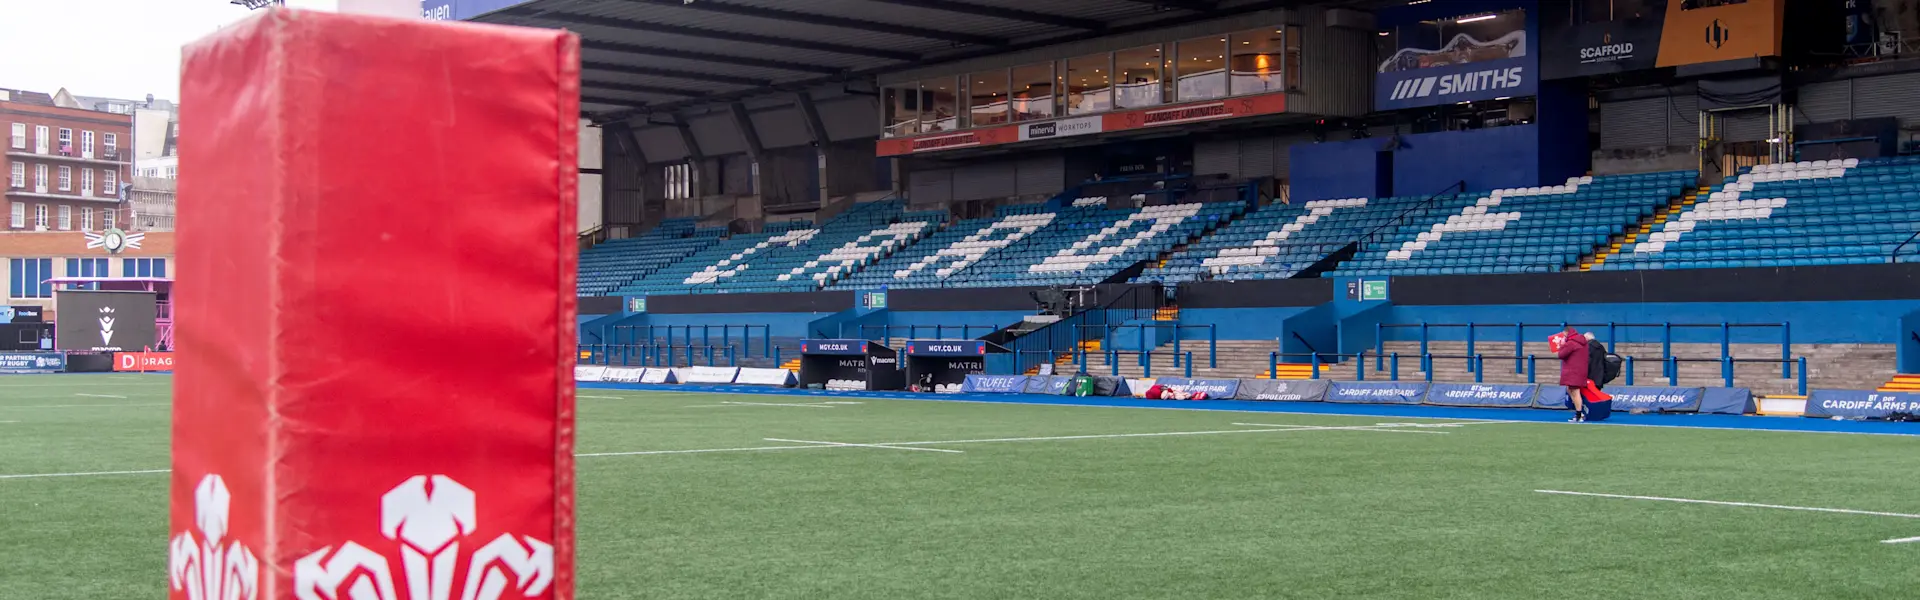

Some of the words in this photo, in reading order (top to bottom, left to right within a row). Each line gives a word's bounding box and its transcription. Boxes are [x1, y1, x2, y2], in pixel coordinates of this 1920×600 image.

[1580, 42, 1634, 59] SCAFFOLD
[1438, 66, 1523, 96] SMITHS
[1143, 109, 1181, 124] LLANDAFF
[1181, 104, 1224, 119] LAMINATES
[1058, 121, 1092, 132] WORKTOPS
[819, 343, 849, 351] MGY.CO.UK
[928, 344, 962, 353] MGY.CO.UK
[142, 357, 175, 366] DRAG
[976, 377, 1015, 388] TRUFFLE
[1338, 388, 1372, 396] CARDIFF
[1372, 388, 1394, 396] ARMS
[1394, 388, 1417, 397] PARK
[1474, 391, 1498, 399] ARMS
[1499, 391, 1523, 399] PARK
[1629, 394, 1657, 403] ARMS
[1658, 394, 1686, 403] PARK
[1868, 394, 1879, 402] BT
[1822, 399, 1873, 409] CARDIFF
[1873, 401, 1907, 410] ARMS
